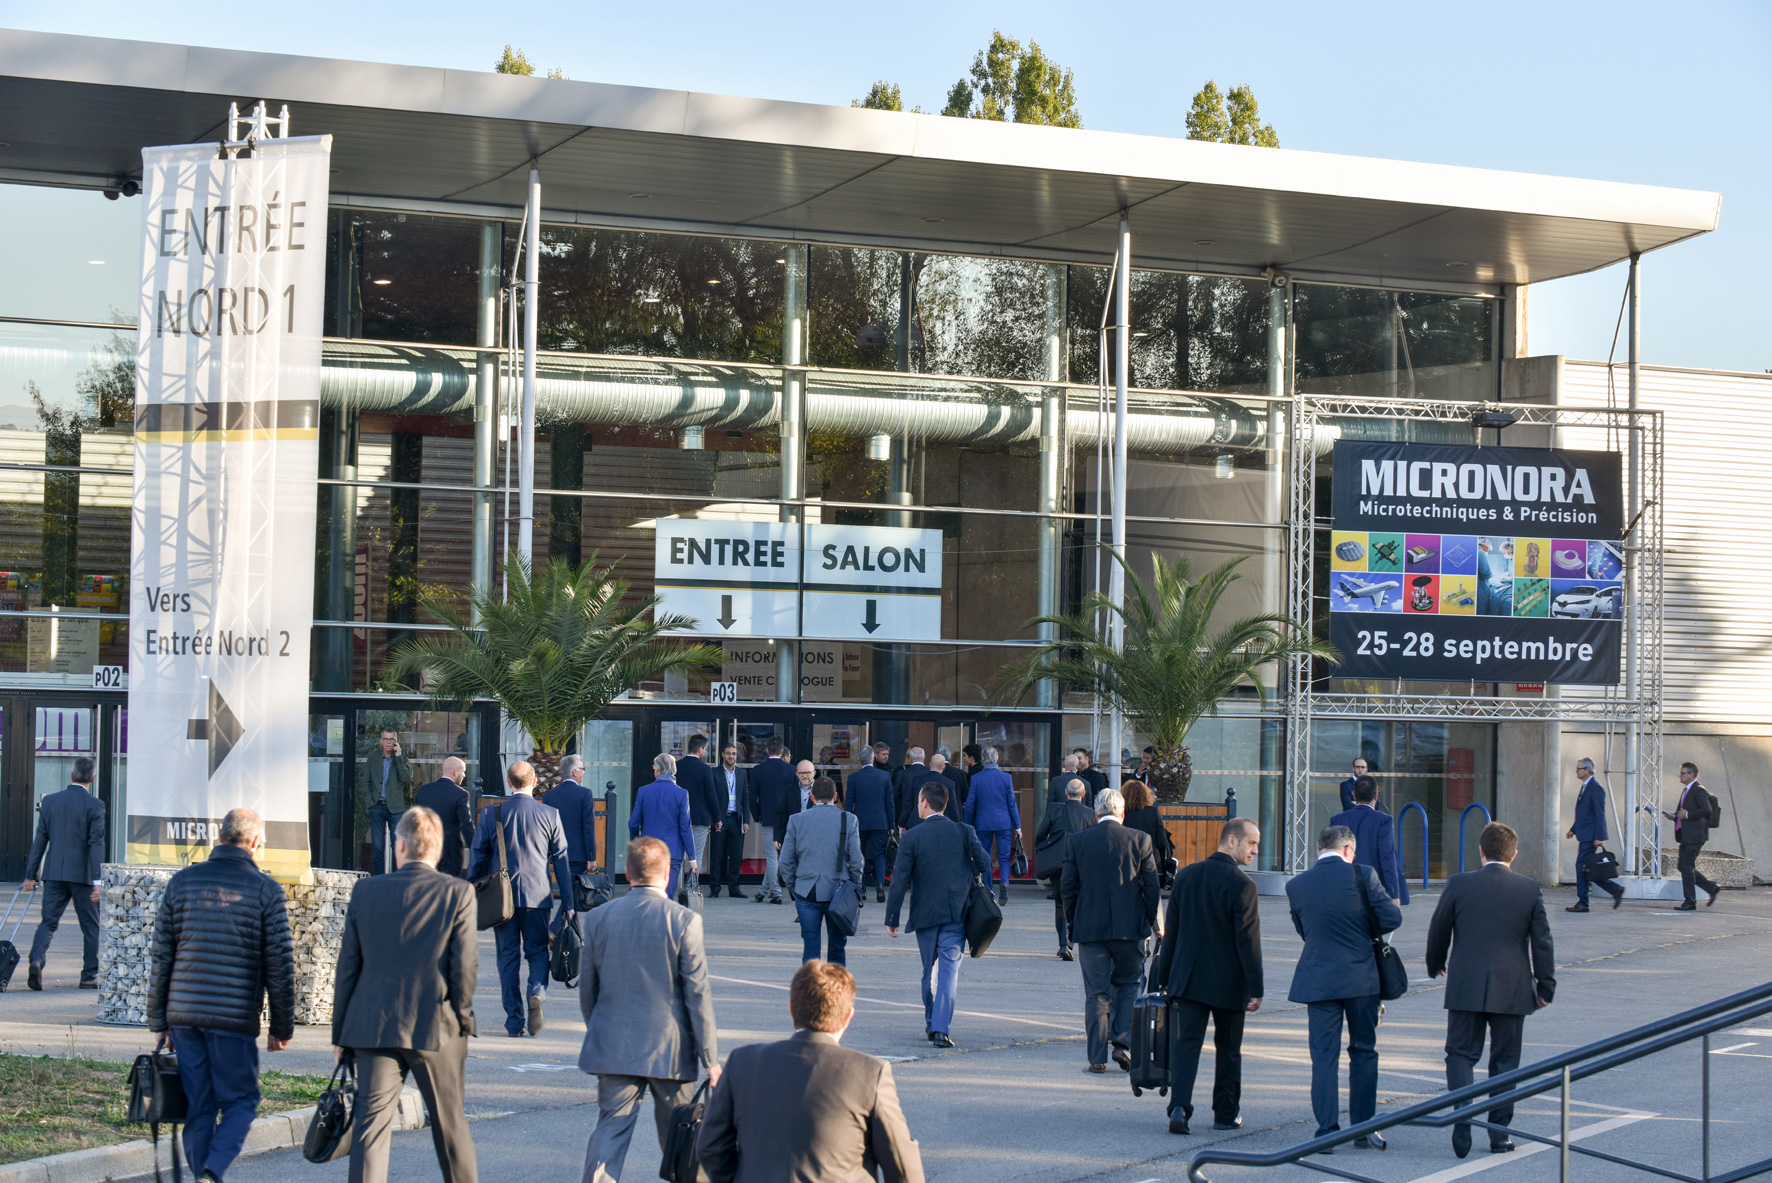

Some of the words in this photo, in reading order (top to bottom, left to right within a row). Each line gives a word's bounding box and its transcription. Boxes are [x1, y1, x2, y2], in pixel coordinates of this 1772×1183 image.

[160, 190, 307, 258] ENTRÉE
[156, 286, 270, 339] NORD
[282, 283, 295, 334] 1
[1360, 459, 1597, 505] MICRONORA
[1359, 500, 1498, 523] Microtechniques
[1502, 505, 1515, 521] &
[1519, 505, 1598, 525] Précision
[669, 536, 786, 568] ENTREE
[821, 543, 927, 574] SALON
[145, 586, 191, 613] Vers
[145, 628, 213, 656] Entrée
[218, 628, 270, 657] Nord
[278, 630, 291, 657] 2
[1356, 630, 1435, 658] 25-28
[1442, 635, 1594, 665] septembre
[730, 675, 763, 686] VENTE
